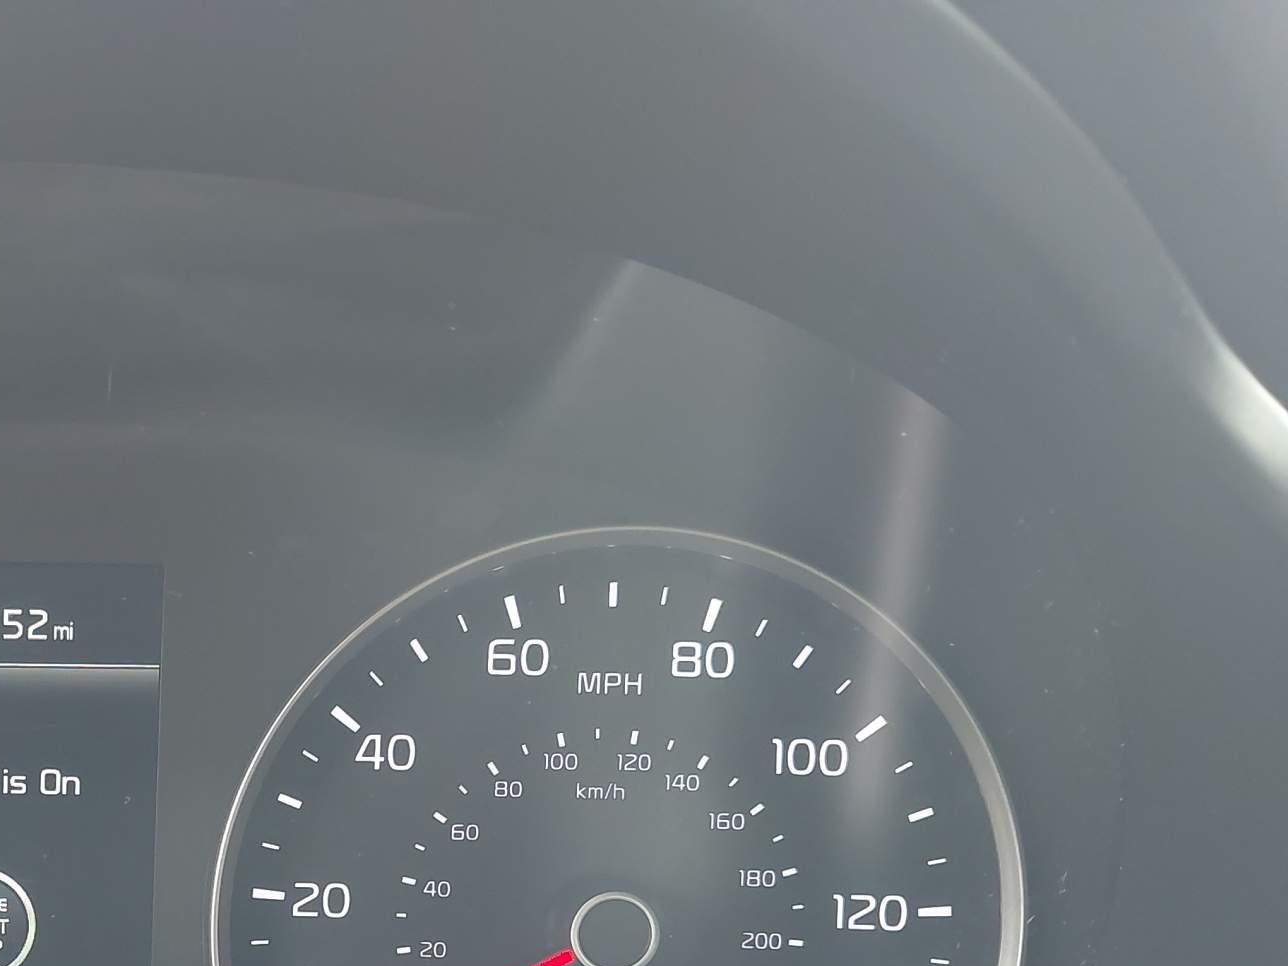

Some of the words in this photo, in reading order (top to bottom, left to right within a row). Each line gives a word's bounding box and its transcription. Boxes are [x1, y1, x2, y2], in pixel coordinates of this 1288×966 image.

[488, 639, 549, 675] 60
[672, 642, 734, 677] 80
[578, 673, 642, 695] MPH
[355, 735, 415, 770] 40
[773, 739, 847, 776] 100
[544, 754, 577, 769] 100
[618, 754, 651, 770] 120
[3, 769, 26, 793] is
[41, 769, 80, 795] On
[495, 782, 522, 797] 80
[666, 775, 699, 790] 140
[577, 783, 624, 799] km/h
[710, 813, 744, 829] 160
[452, 825, 478, 840] 60
[740, 870, 775, 887] 180
[424, 881, 450, 897] 40
[293, 883, 350, 917] 20
[833, 895, 907, 930] 120
[742, 933, 781, 949] 200
[421, 942, 446, 957] 20
